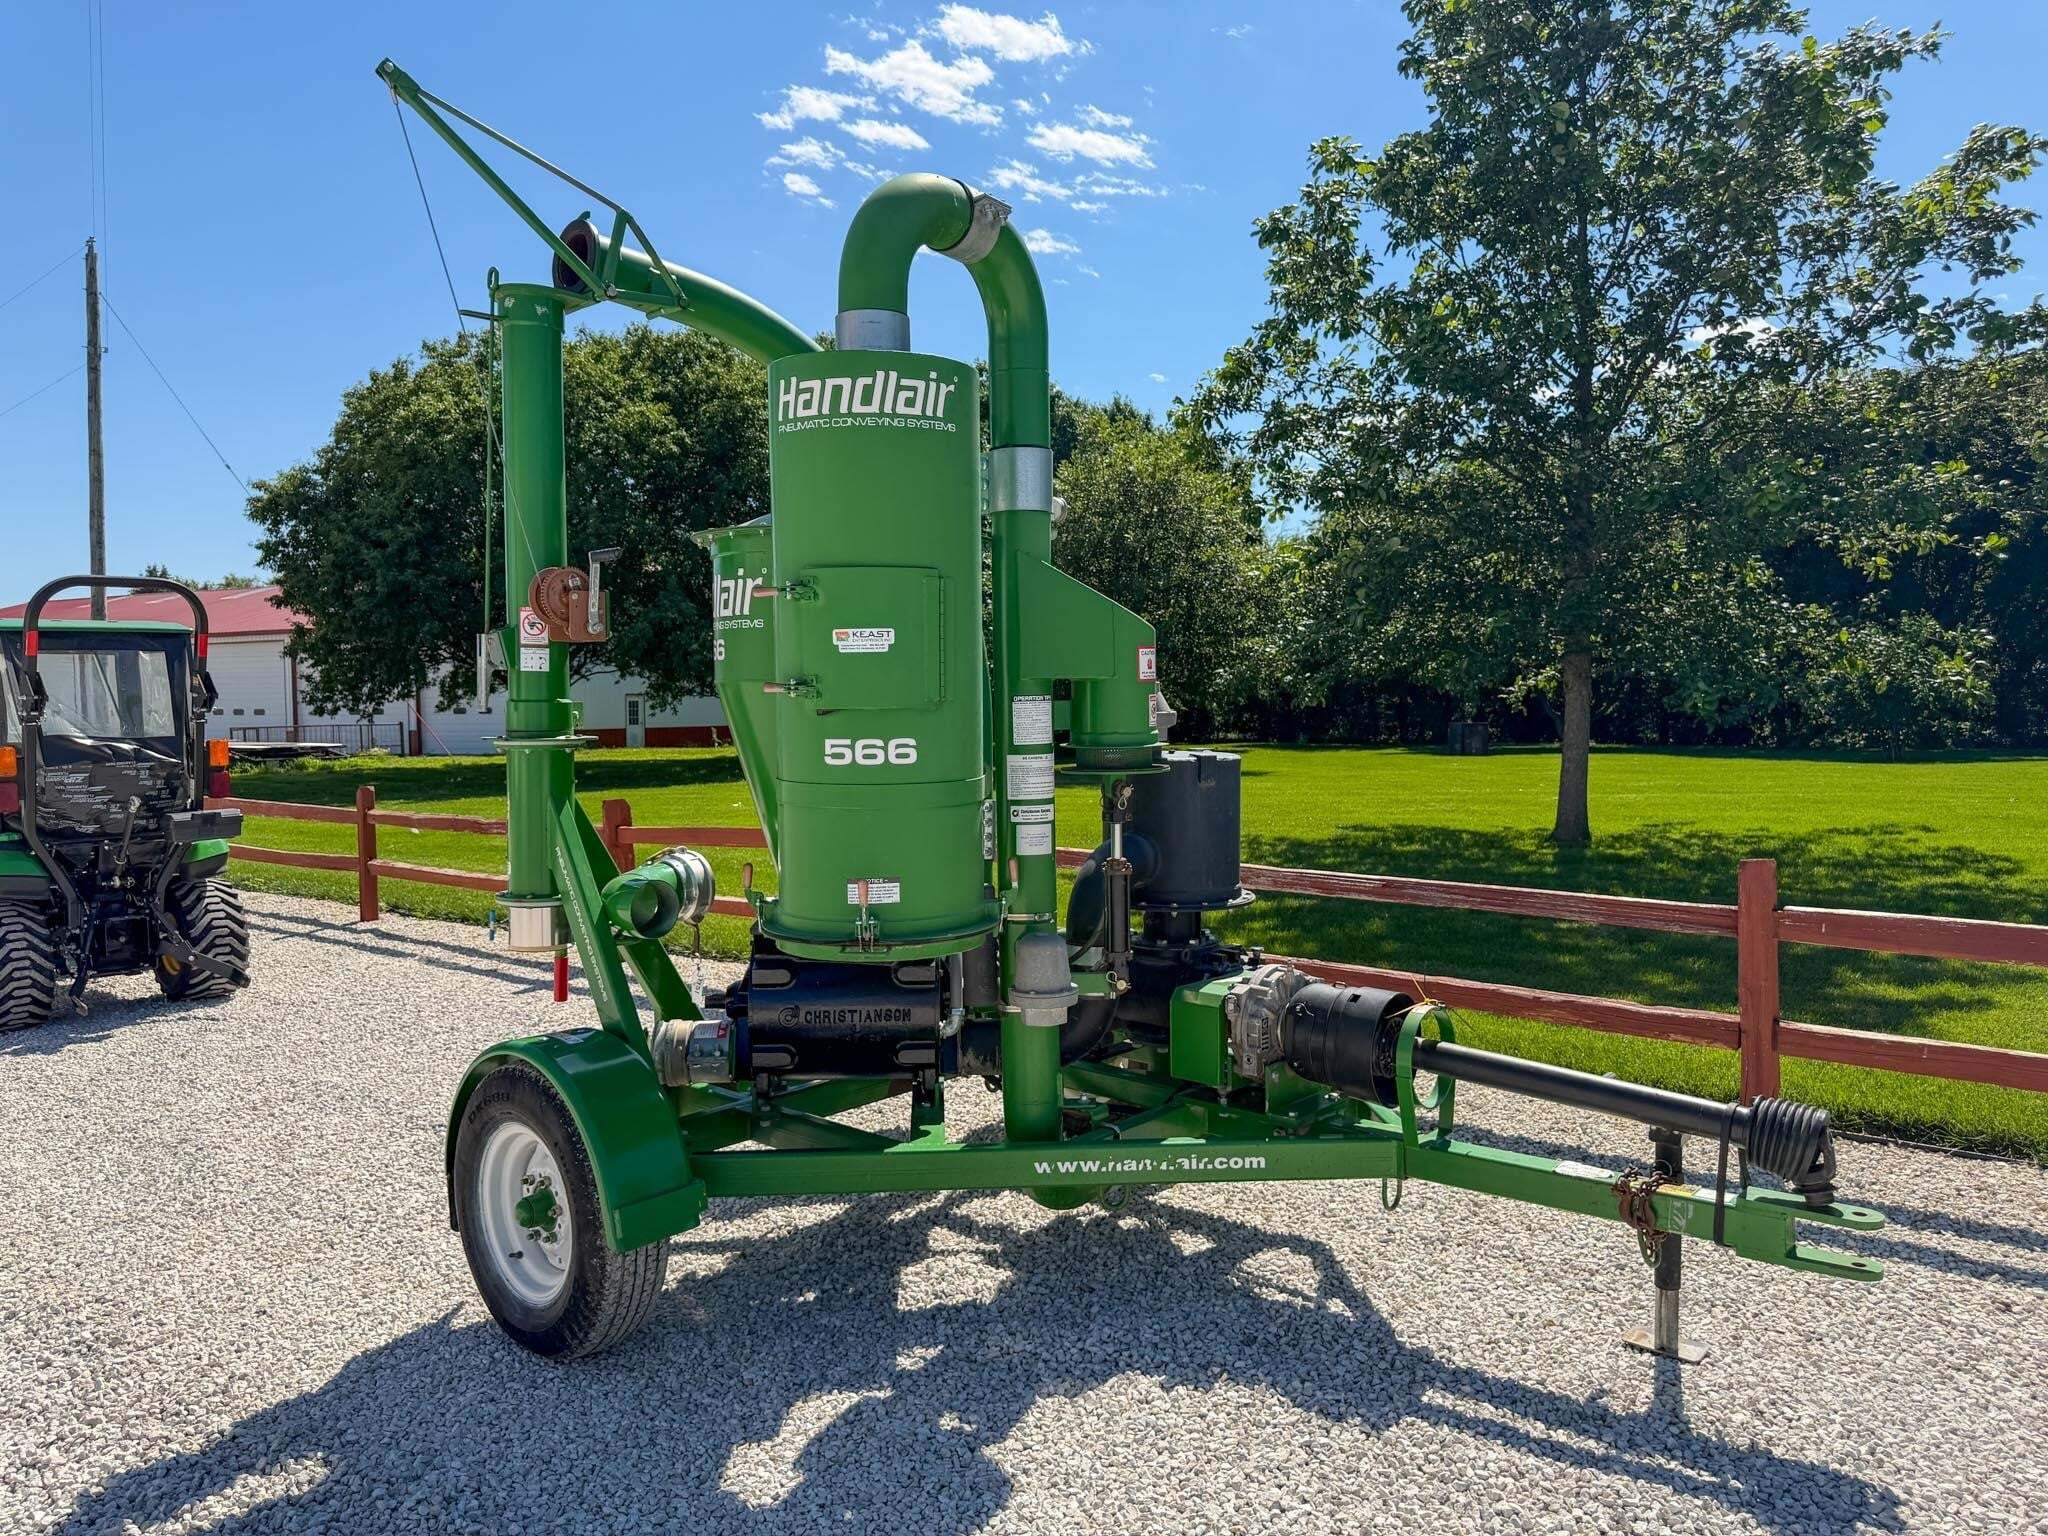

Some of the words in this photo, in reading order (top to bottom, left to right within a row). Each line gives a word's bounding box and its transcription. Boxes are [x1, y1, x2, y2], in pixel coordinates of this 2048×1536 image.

[778, 370, 955, 421] Handlair
[778, 417, 829, 432] PNEUMATIC
[831, 417, 905, 427] CONVEYING
[907, 419, 956, 432] SYSTEMS
[712, 567, 763, 618] lair
[852, 630, 892, 638] KEAST
[824, 738, 918, 765] 566
